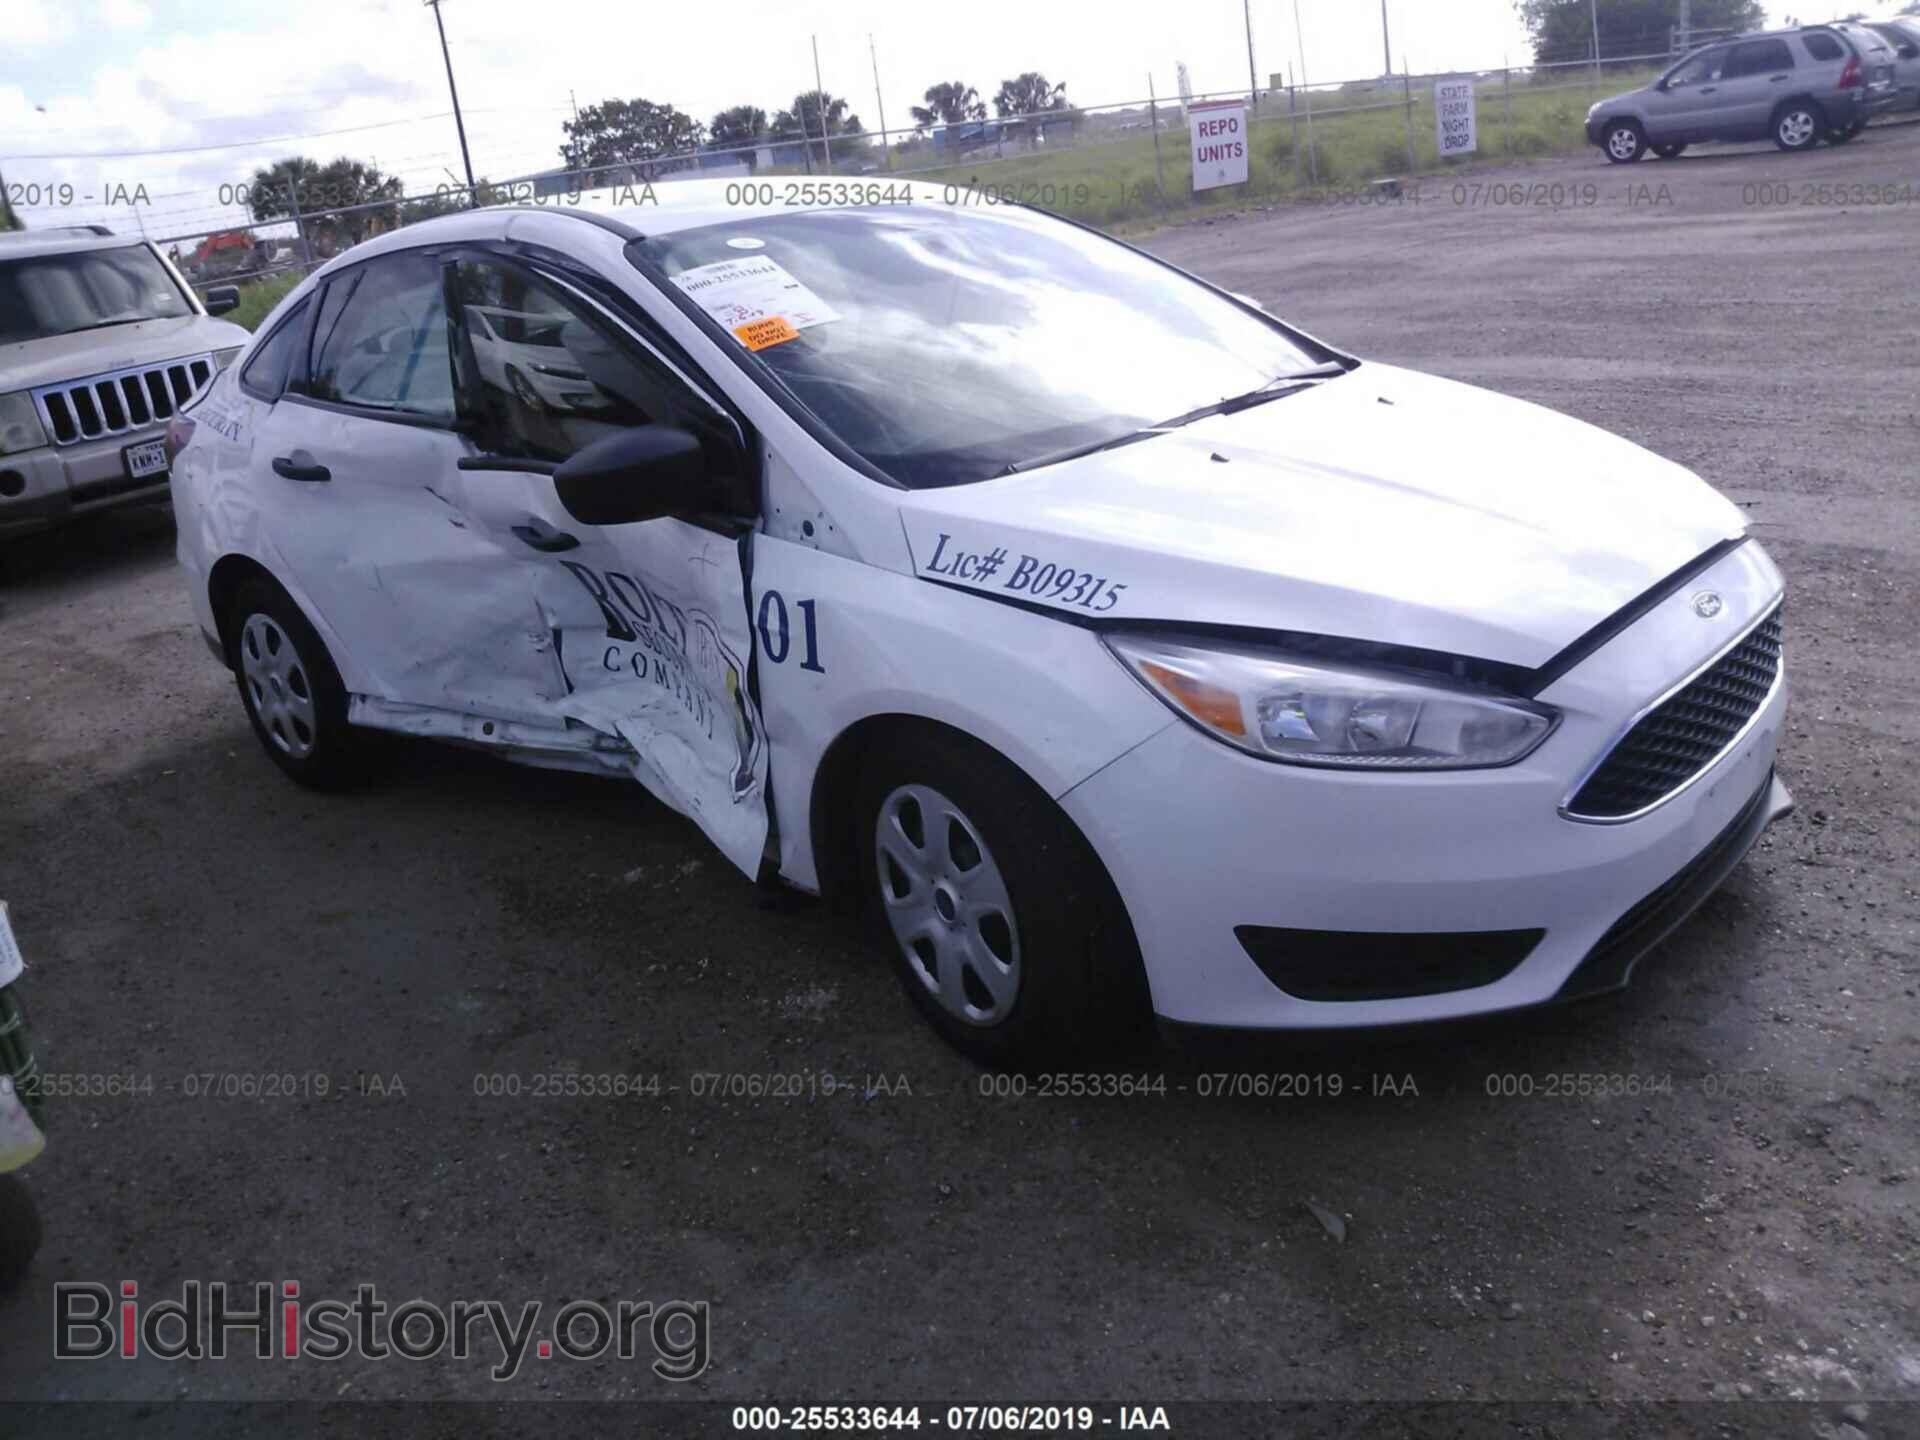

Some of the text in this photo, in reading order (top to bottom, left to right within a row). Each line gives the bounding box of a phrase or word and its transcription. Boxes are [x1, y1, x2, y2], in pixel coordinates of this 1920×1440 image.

[1441, 86, 1469, 98] STATE
[1198, 117, 1239, 138] REPO
[1442, 117, 1470, 133] NIGHT
[1445, 133, 1470, 150] DROP
[1197, 142, 1244, 163] UNITS
[1004, 554, 1128, 611] B09315
[757, 590, 826, 674] 01
